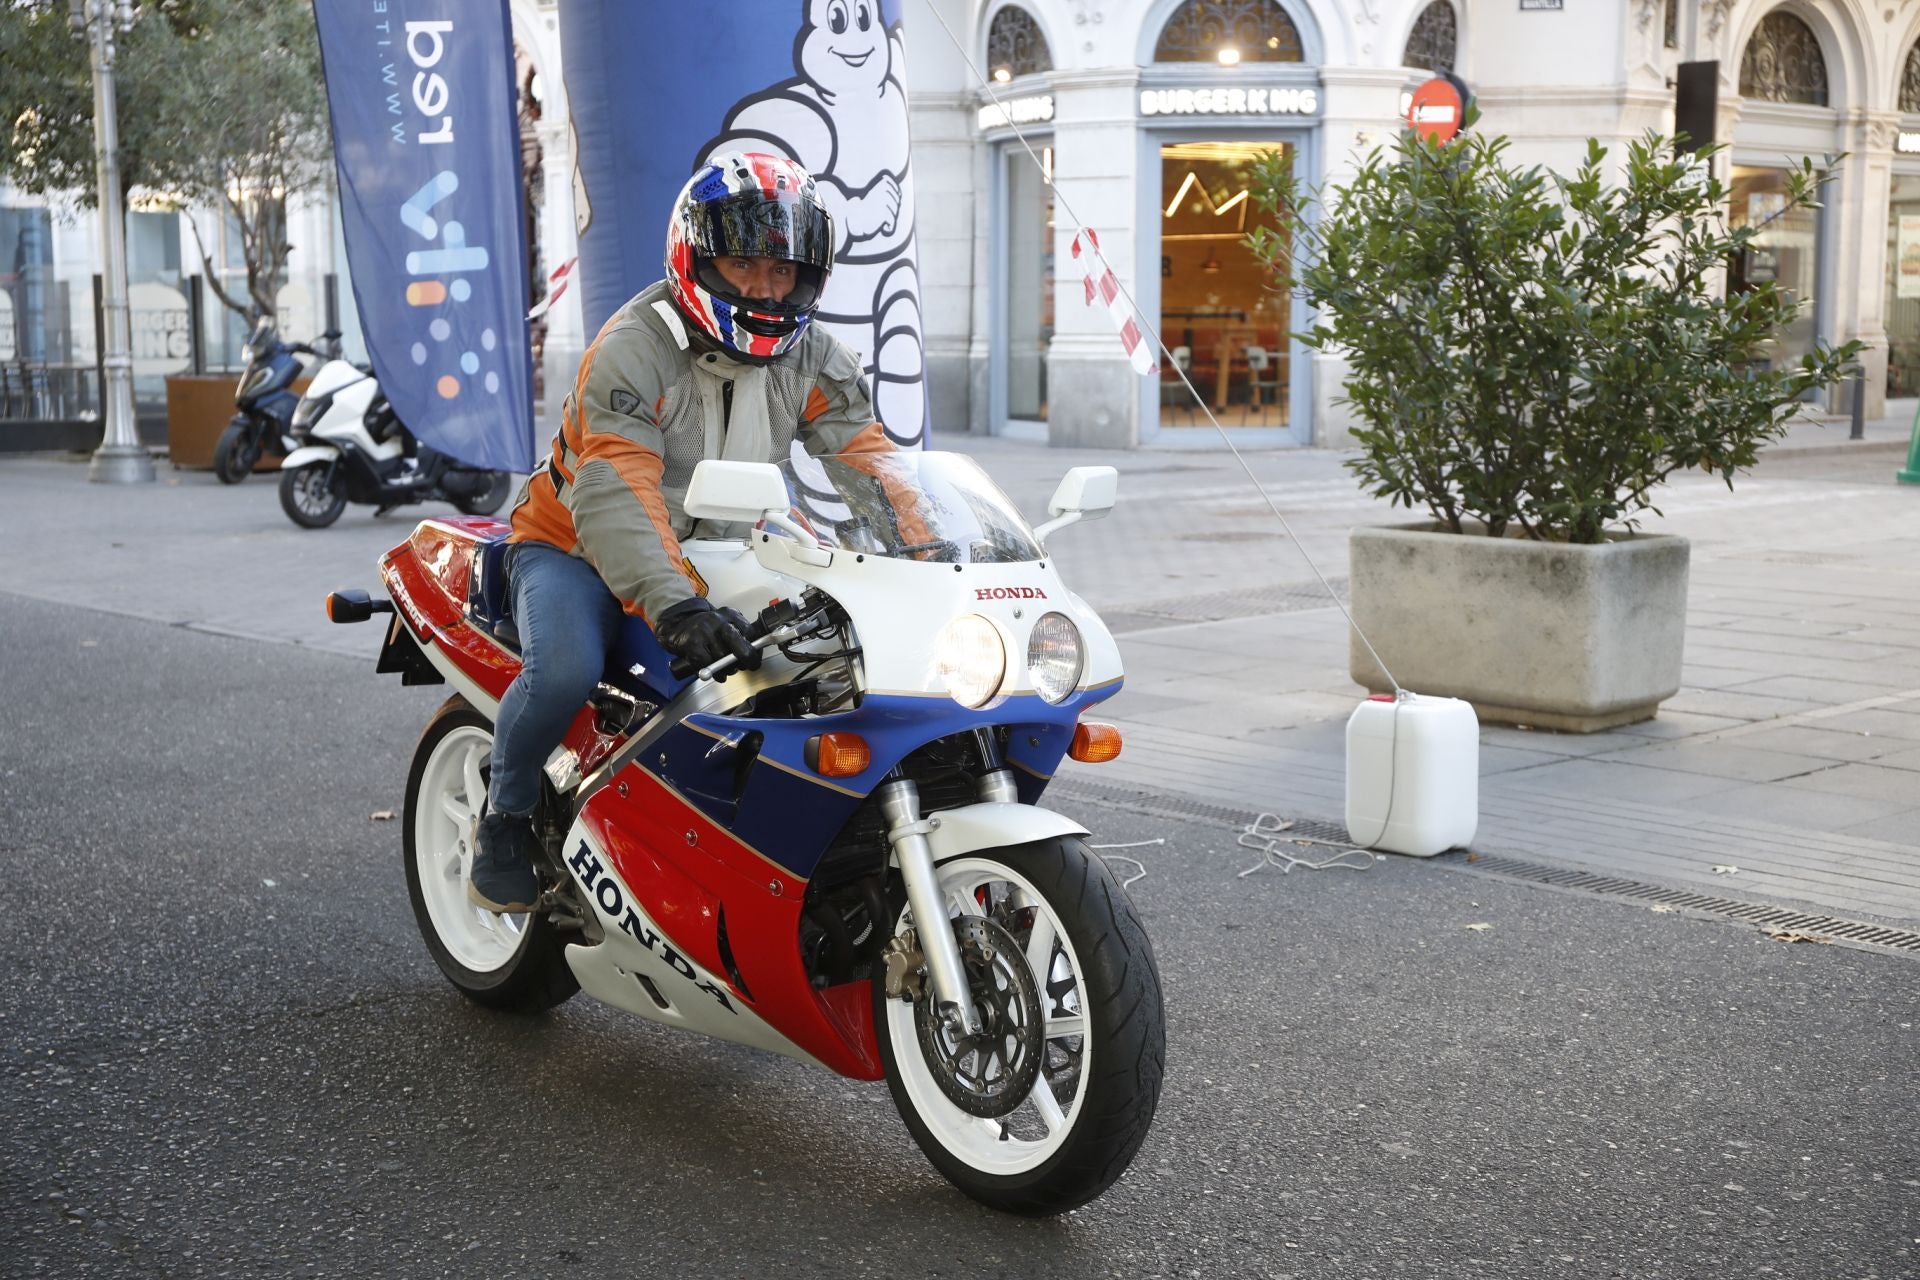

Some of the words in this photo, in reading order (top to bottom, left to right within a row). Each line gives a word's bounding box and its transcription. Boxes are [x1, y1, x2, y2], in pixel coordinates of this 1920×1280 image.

[1140, 89, 1246, 115] BURGER
[1247, 89, 1317, 114] KING
[135, 331, 191, 358] ING
[974, 587, 1048, 600] HONDA
[568, 838, 738, 1015] HONDA
